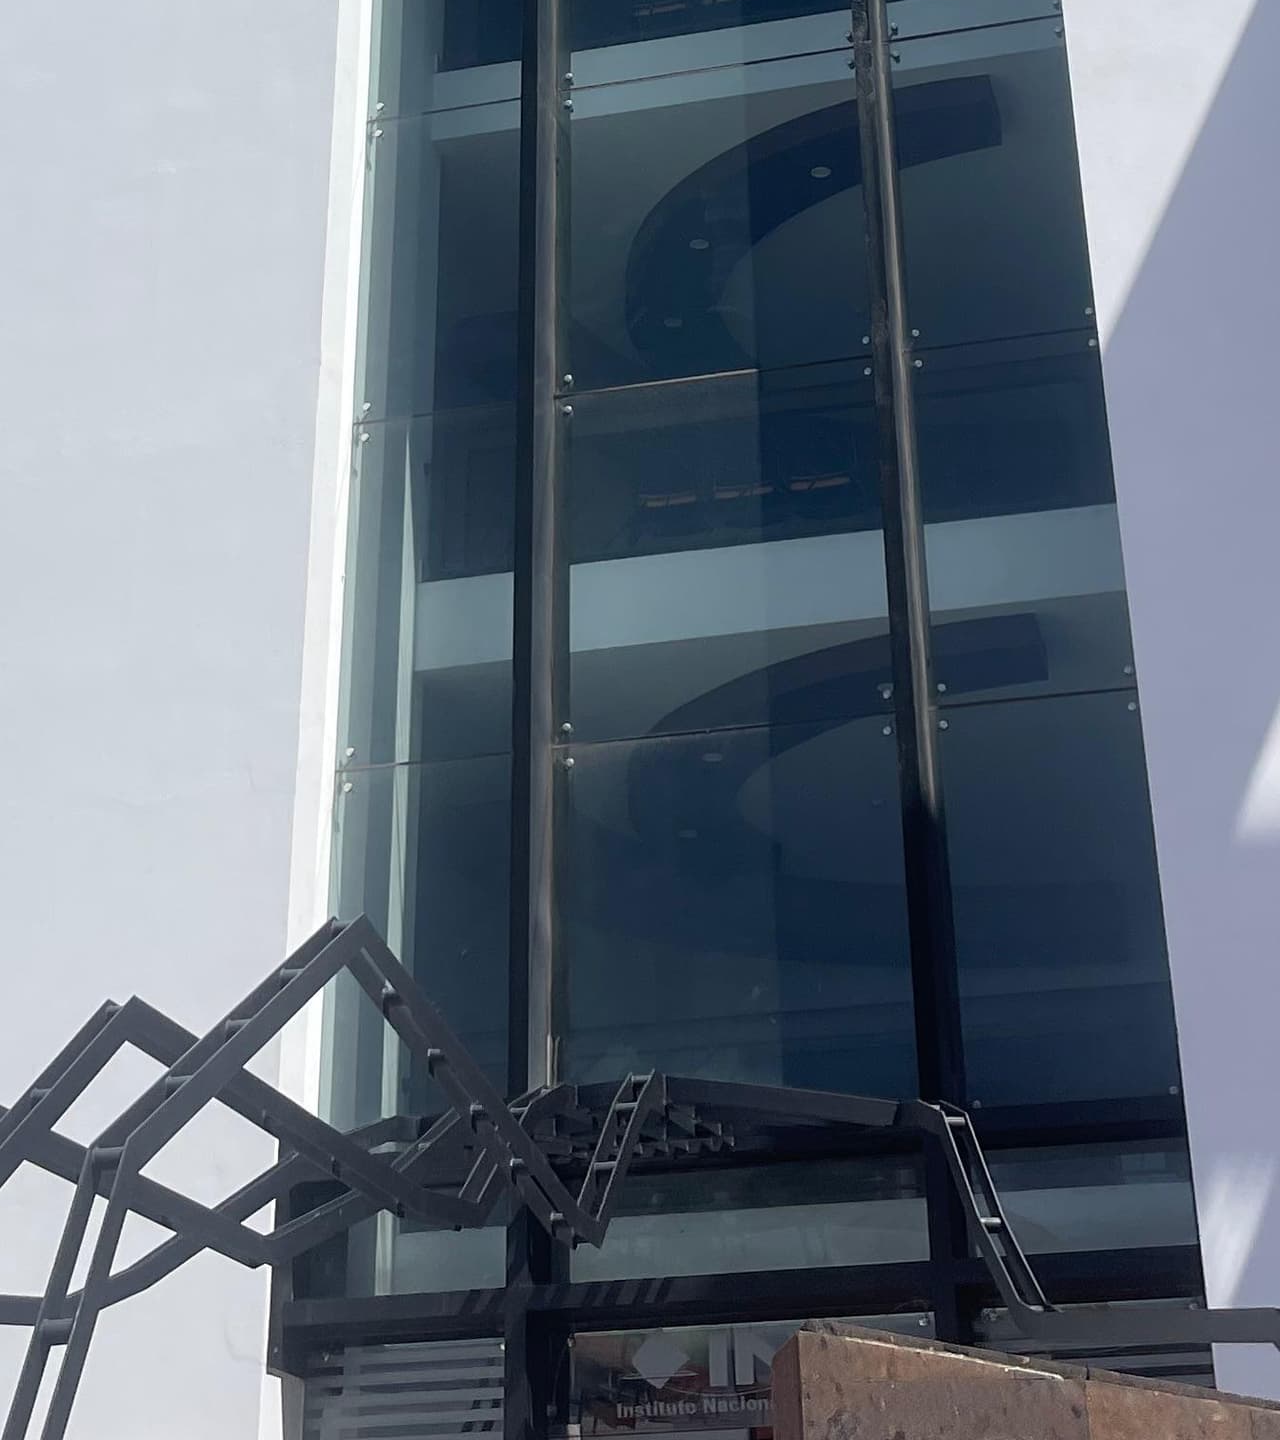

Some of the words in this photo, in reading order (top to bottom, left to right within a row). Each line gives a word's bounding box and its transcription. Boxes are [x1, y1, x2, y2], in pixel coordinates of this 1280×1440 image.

[709, 1328, 775, 1387] IN
[616, 1399, 697, 1418] Instituto
[703, 1396, 774, 1415] Nacion
